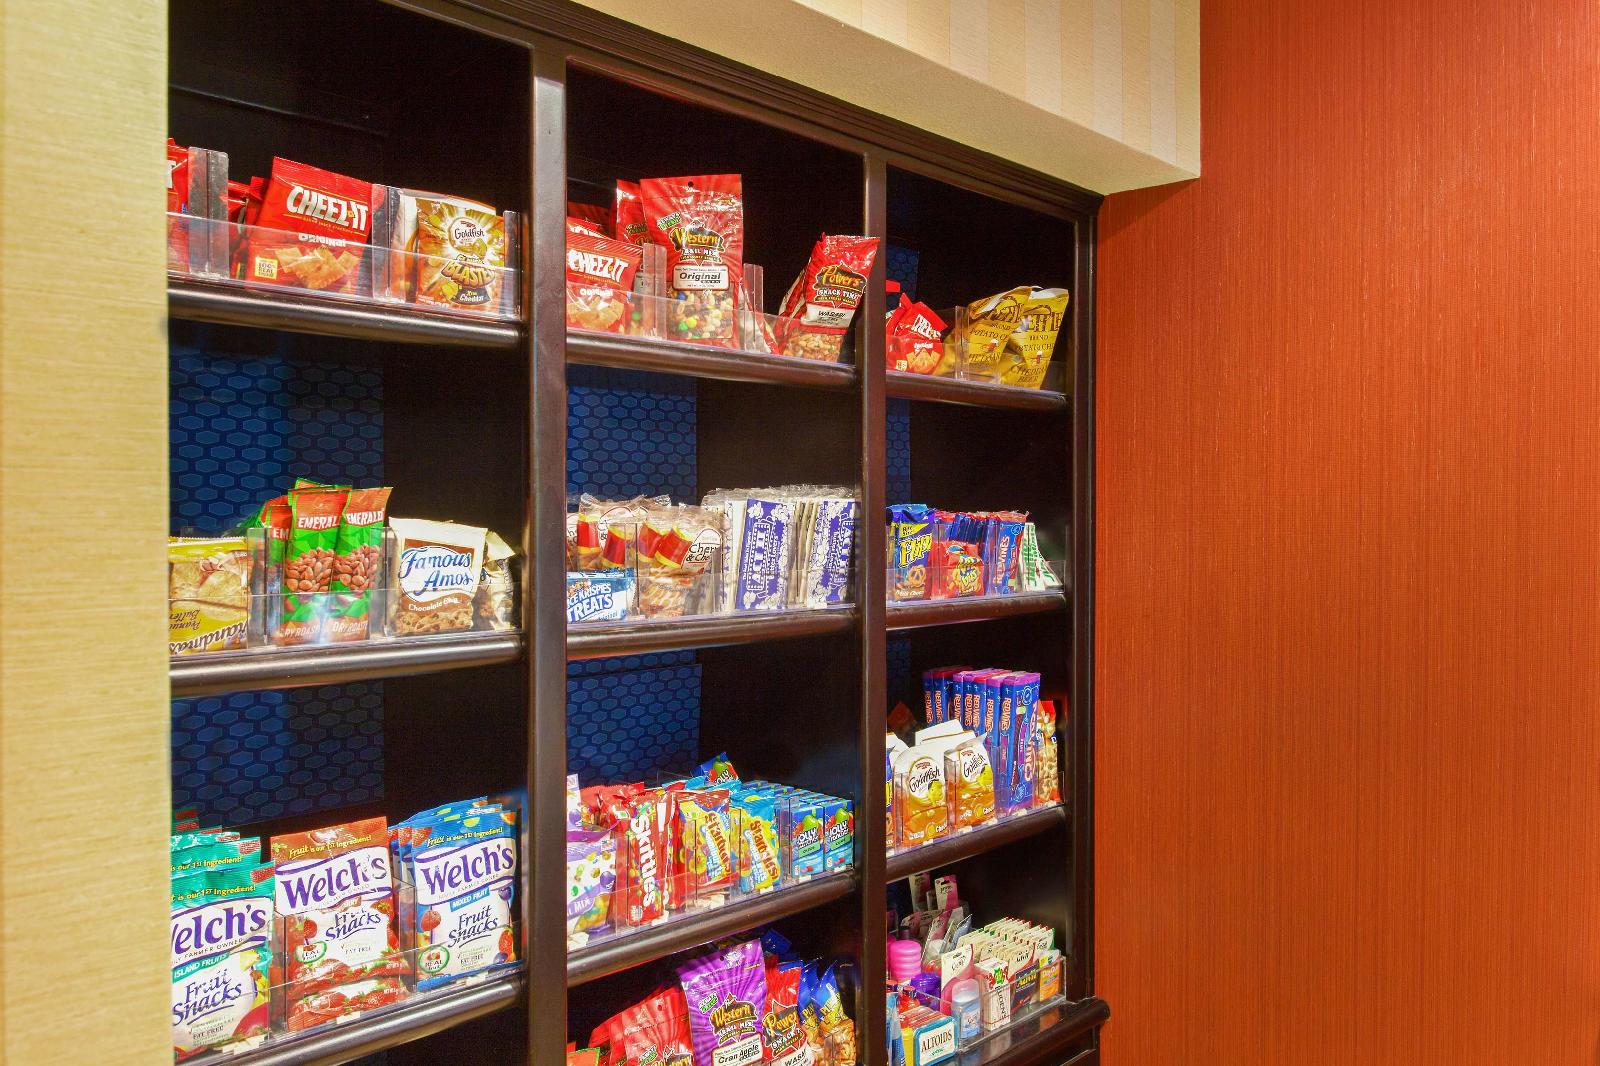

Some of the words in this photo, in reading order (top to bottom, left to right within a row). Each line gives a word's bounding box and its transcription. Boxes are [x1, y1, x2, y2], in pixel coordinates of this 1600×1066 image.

[454, 226, 485, 240] Goldfish
[670, 225, 718, 252] Western
[679, 272, 721, 281] Original
[298, 515, 338, 528] EMERAL
[346, 511, 384, 525] EMERALD
[398, 546, 472, 579] Famous
[413, 569, 474, 596] Amos
[567, 593, 614, 623] TREATS
[714, 769, 729, 784] OLLY
[963, 753, 986, 778] Goldfish
[909, 765, 941, 793] Goldfish
[289, 844, 310, 859] Fruit
[426, 836, 445, 848] Fruit
[419, 843, 514, 895] Welch's
[280, 854, 388, 909] Welch's
[574, 898, 592, 911] MIX
[325, 912, 381, 940] Snacks
[458, 904, 492, 931] Fruit
[216, 937, 243, 950] OWNED
[447, 917, 499, 948] Snacks
[174, 961, 201, 978] ISLAND
[424, 959, 443, 968] REAL
[184, 968, 232, 1004] Fruit
[172, 983, 242, 1026] Snacks
[709, 1004, 752, 1028] Western
[921, 1029, 953, 1053] ALTOIDS
[718, 1053, 739, 1065] Cran
